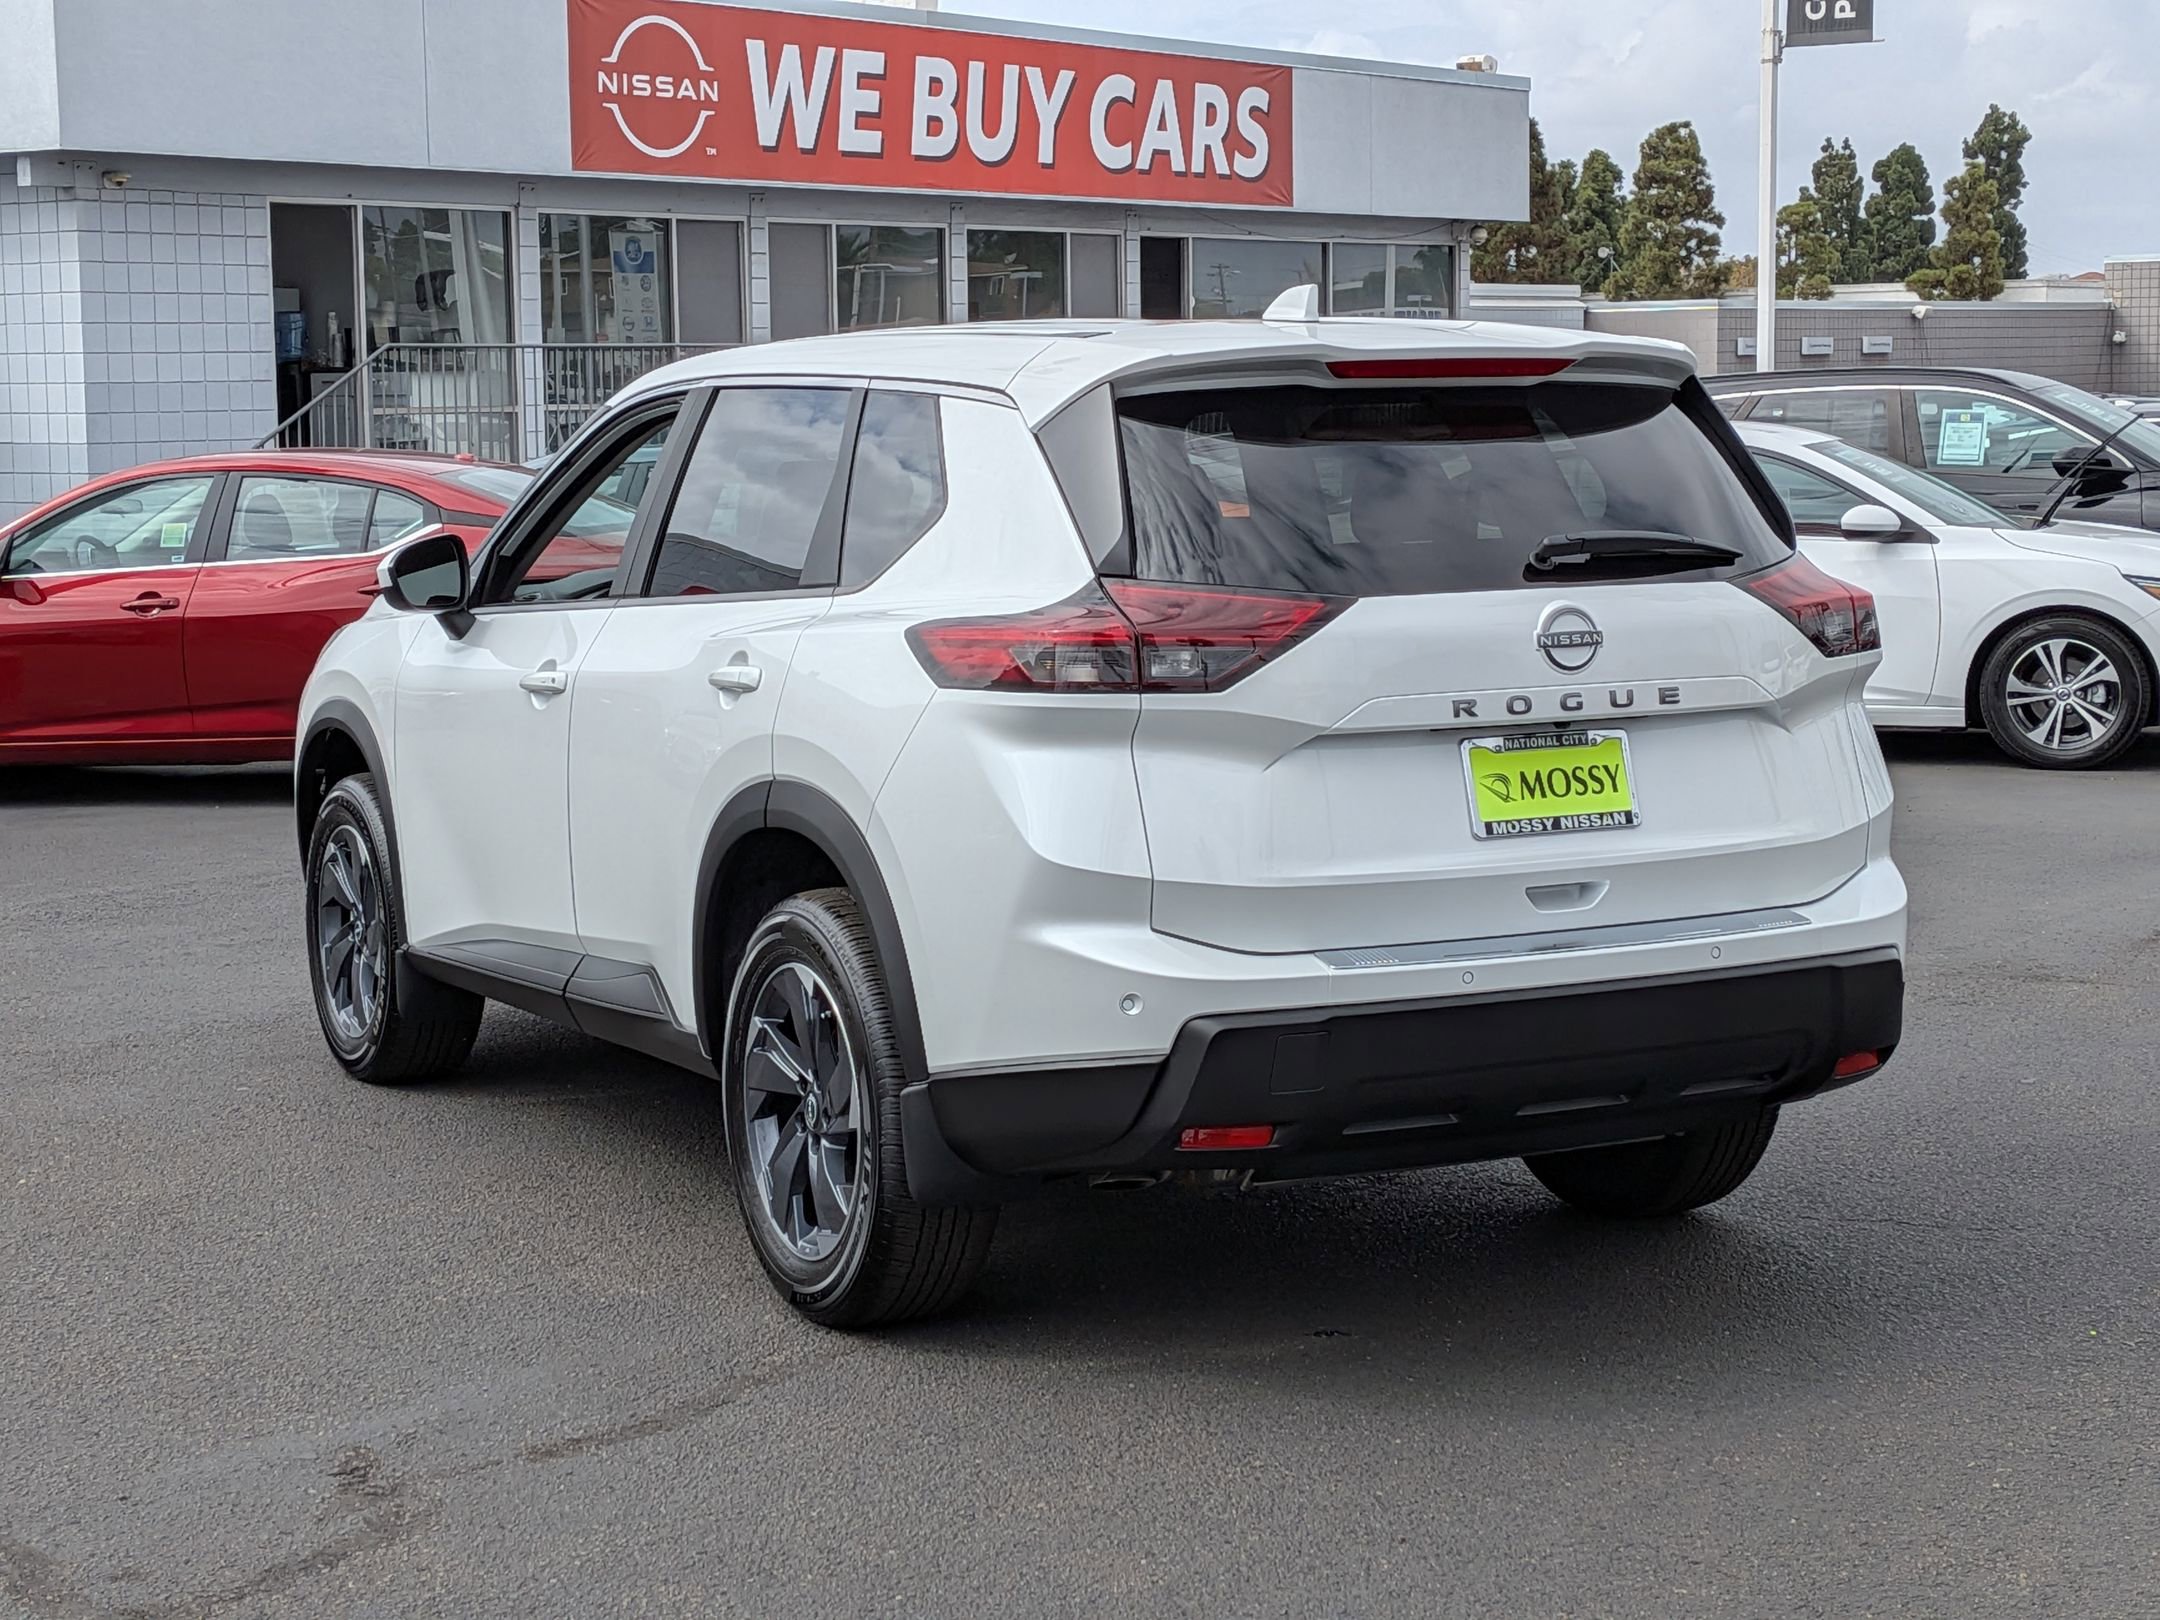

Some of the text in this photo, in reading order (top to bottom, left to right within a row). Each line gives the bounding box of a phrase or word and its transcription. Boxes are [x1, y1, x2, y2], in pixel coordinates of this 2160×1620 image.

[597, 70, 719, 102] NISSAN
[745, 38, 1271, 179] WE BUY CARS
[1540, 633, 1602, 647] NISSAN
[1452, 686, 1681, 719] ROGUE
[1504, 734, 1588, 750] NATIONAL CITY
[1519, 763, 1620, 801] MOSSY
[1491, 811, 1627, 835] MOSSY NISSAN
